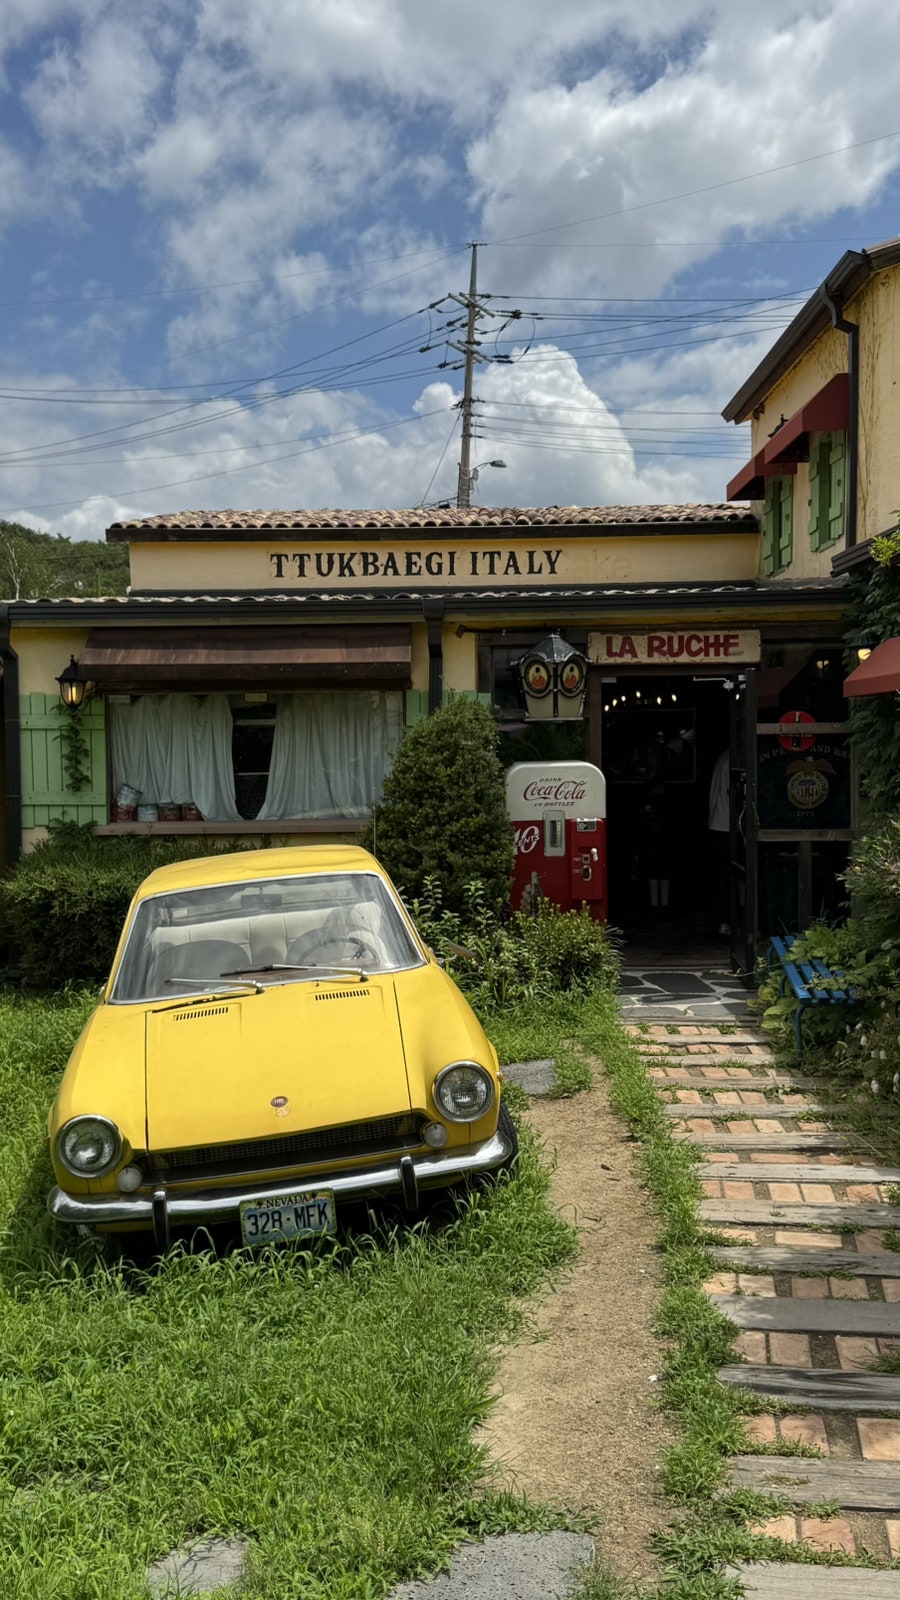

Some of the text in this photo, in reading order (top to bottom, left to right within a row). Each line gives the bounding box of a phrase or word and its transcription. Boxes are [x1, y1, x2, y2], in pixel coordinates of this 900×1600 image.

[269, 550, 562, 578] TTUKBAEGI ITALY
[606, 634, 740, 658] LA RUCHE
[810, 744, 832, 754] AND
[523, 780, 587, 801] Coca-Cola
[266, 1194, 308, 1208] NEVADA
